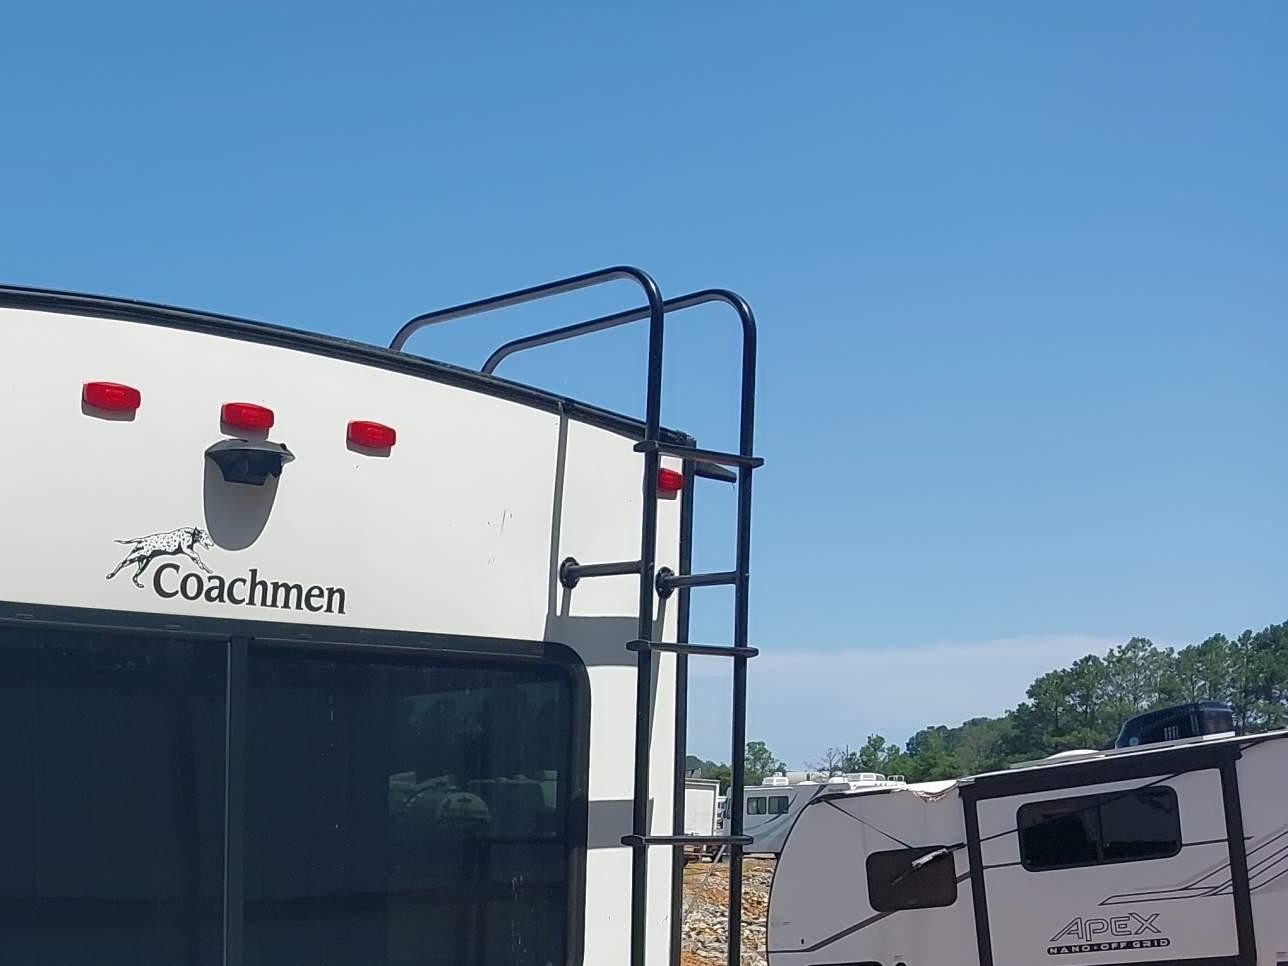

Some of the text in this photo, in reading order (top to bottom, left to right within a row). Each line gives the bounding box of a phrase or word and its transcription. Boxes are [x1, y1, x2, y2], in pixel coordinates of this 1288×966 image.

[153, 562, 346, 614] Coachmen
[1049, 912, 1161, 942] APEX
[1049, 939, 1169, 954] NANO OFF GRID
